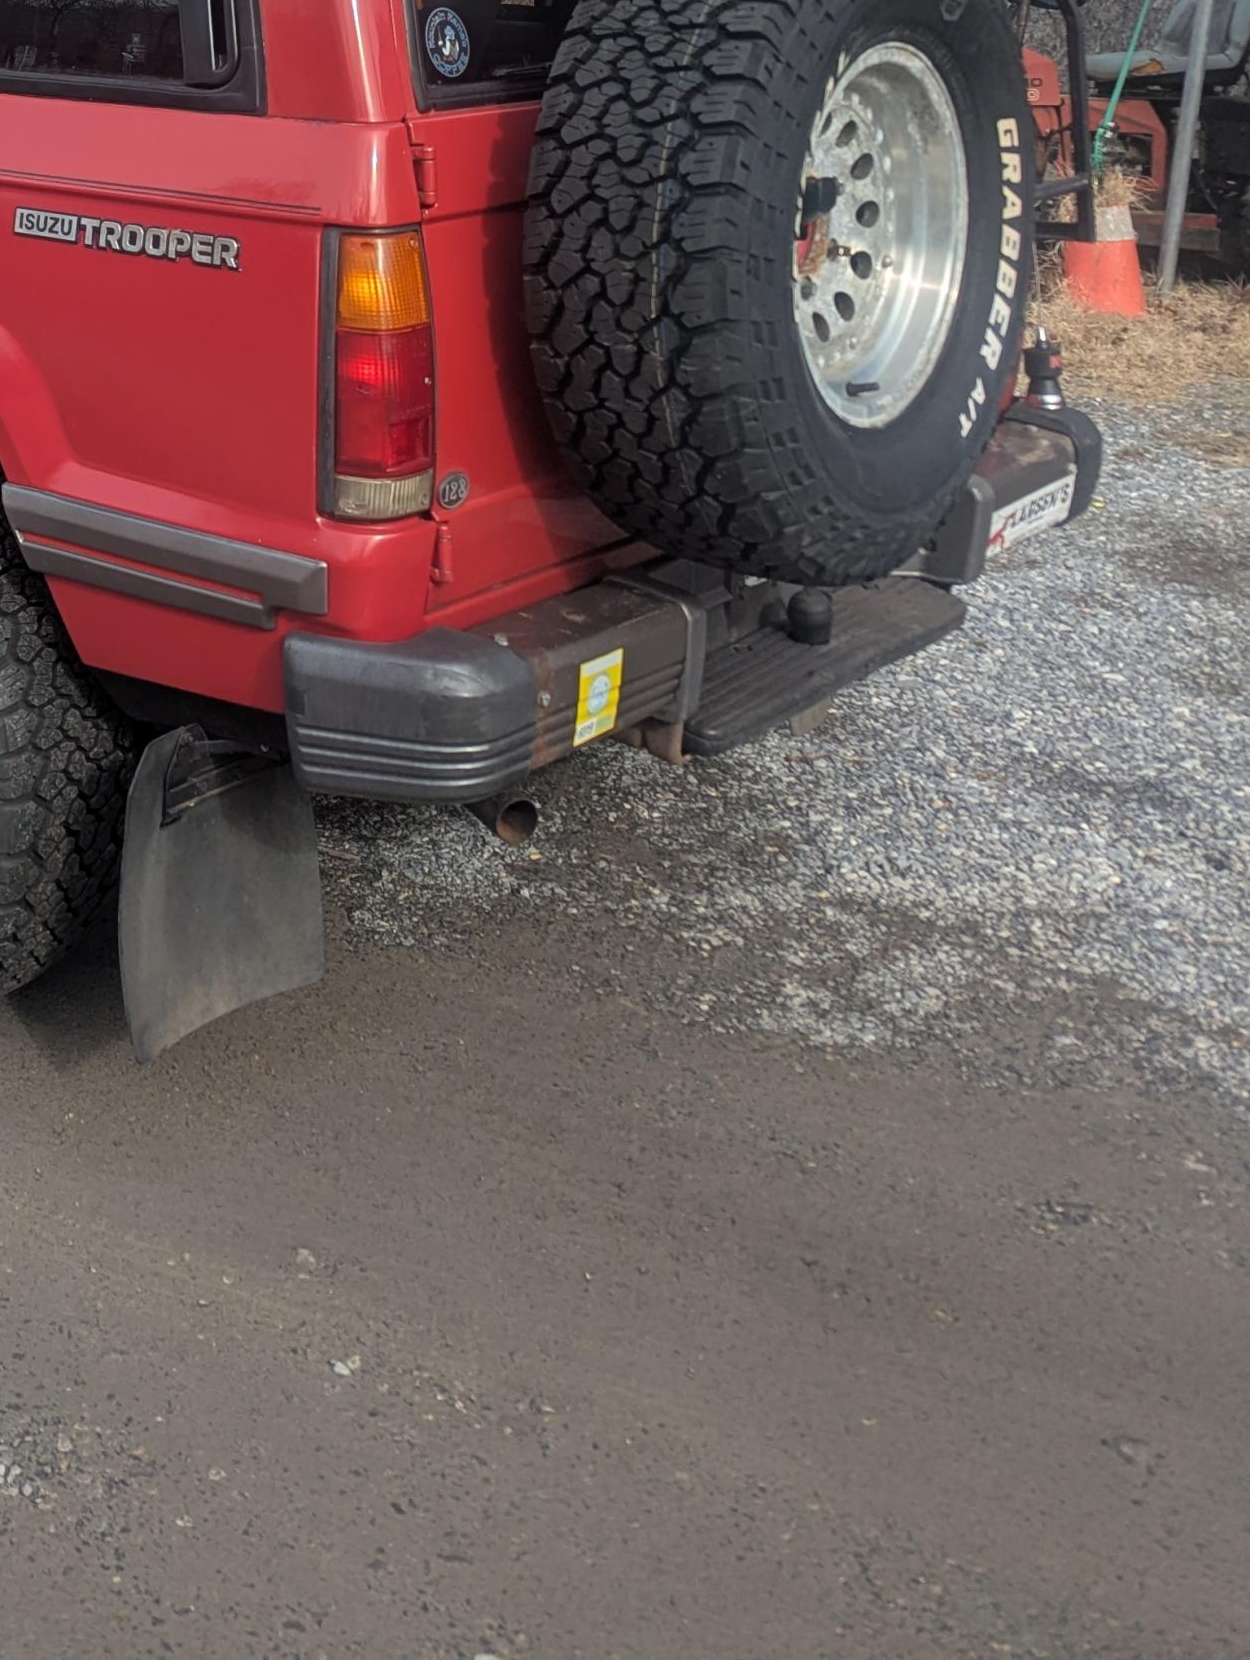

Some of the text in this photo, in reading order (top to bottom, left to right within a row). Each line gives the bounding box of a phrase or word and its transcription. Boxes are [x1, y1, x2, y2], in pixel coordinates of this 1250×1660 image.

[18, 212, 240, 269] ISUZU TROOPER
[958, 116, 1022, 439] GRABBER A/T
[443, 477, 467, 503] 128
